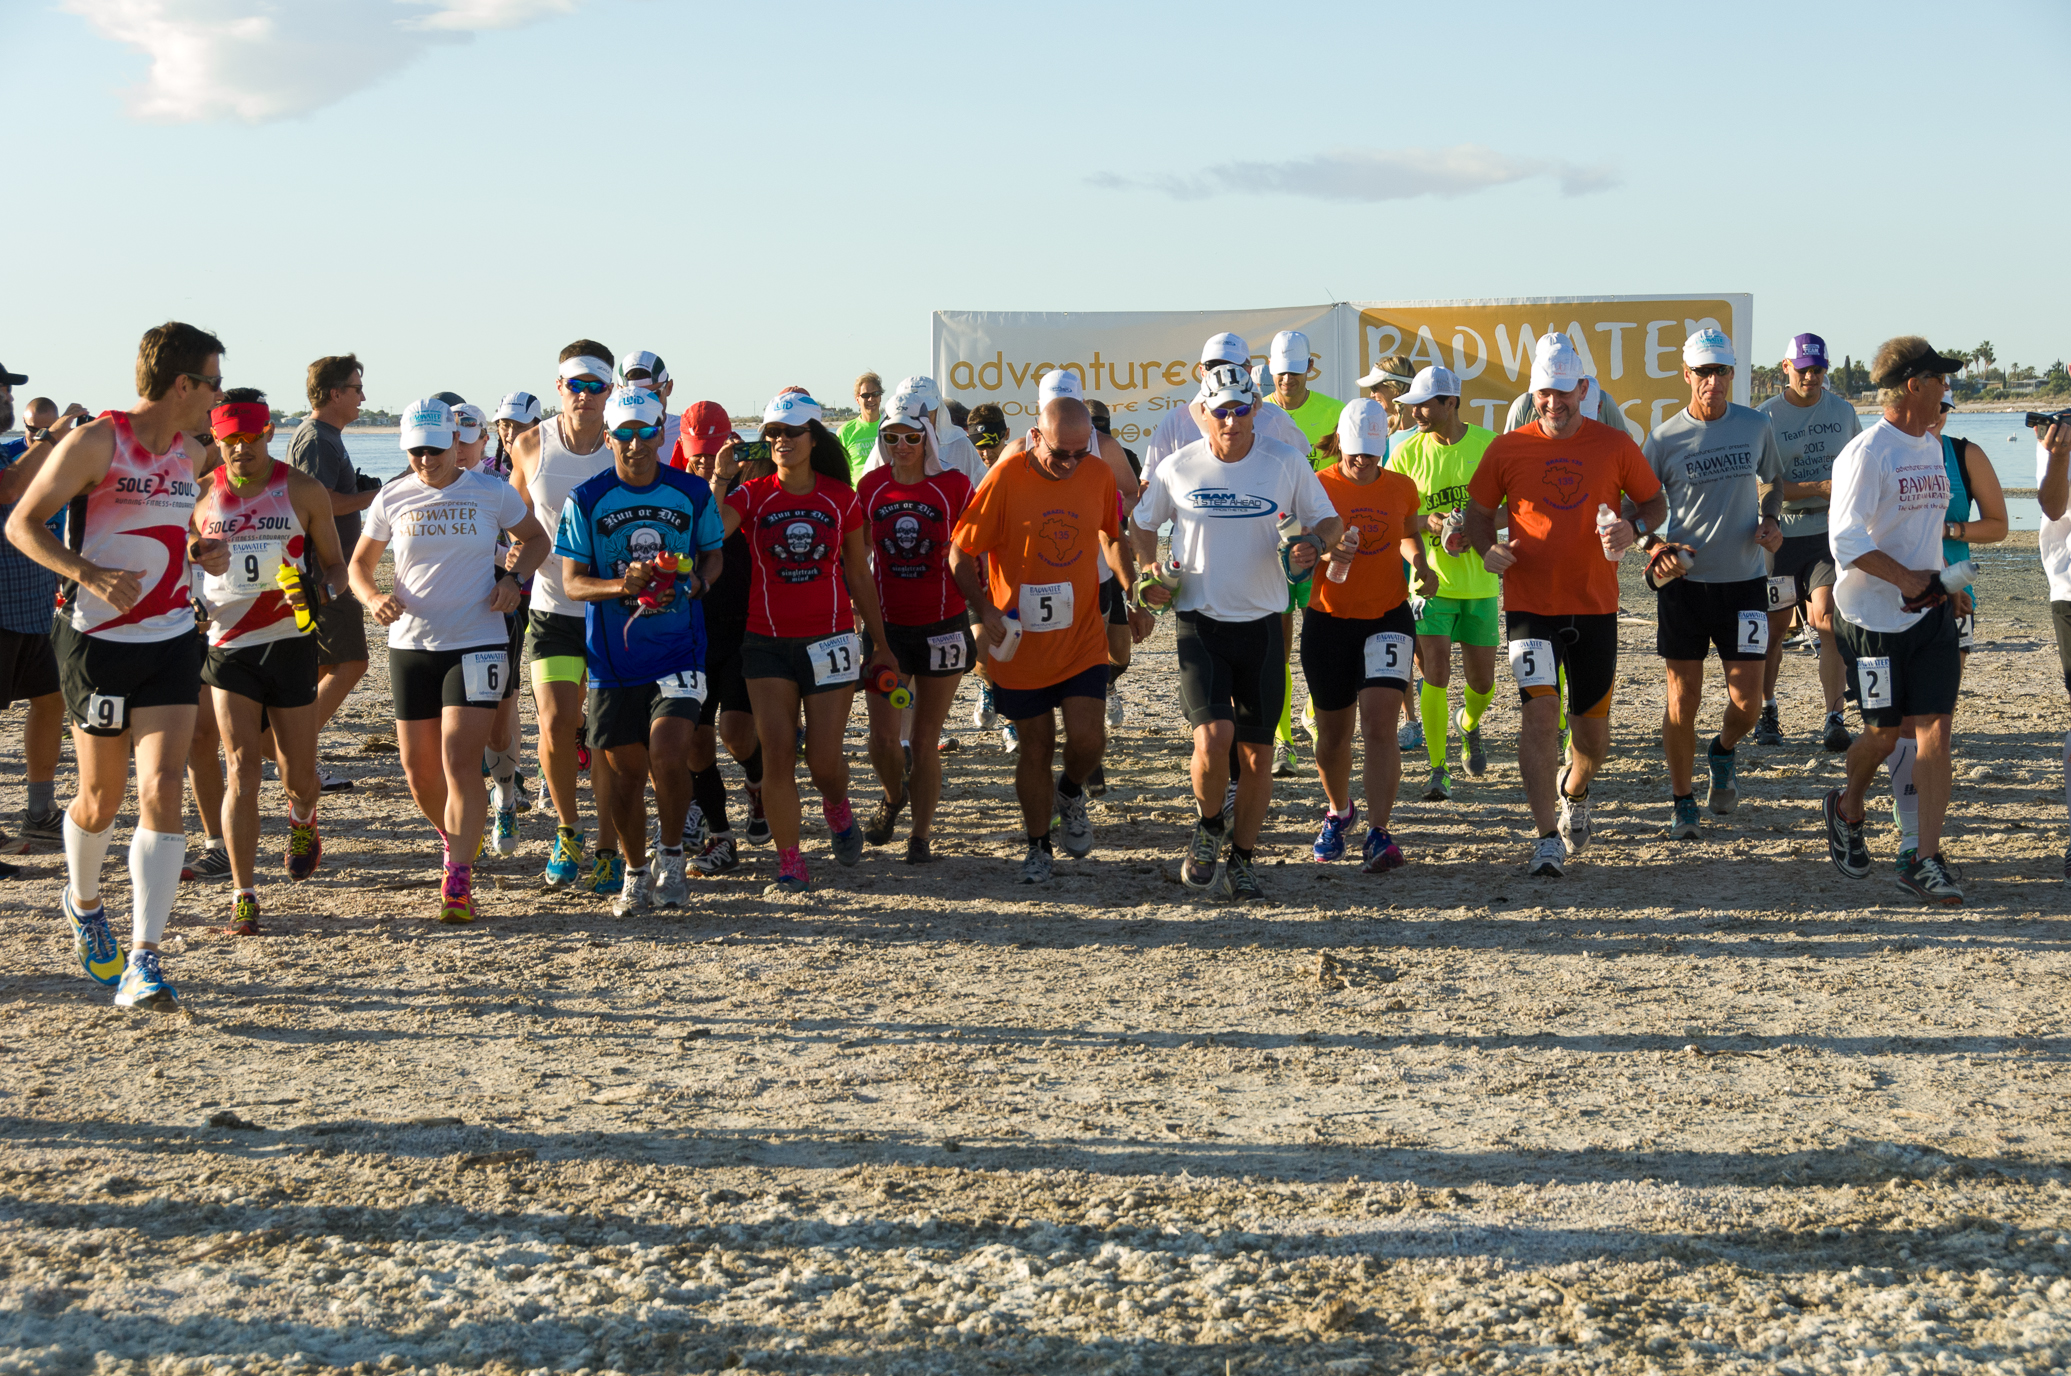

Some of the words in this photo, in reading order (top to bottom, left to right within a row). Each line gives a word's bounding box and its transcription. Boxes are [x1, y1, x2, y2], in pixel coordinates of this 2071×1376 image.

[1213, 368, 1240, 387] 11
[1781, 429, 1806, 442] Team
[1808, 423, 1842, 436] FOMO
[1803, 441, 1825, 454] 2013
[1545, 457, 1569, 466] BRAZIL
[1685, 451, 1752, 475] BADWATER
[1558, 477, 1574, 486] 135
[1688, 464, 1753, 480] ULTRAMARATHON
[116, 477, 153, 493] SOLE
[170, 480, 195, 497] SOUL
[115, 498, 142, 506] RUNNING
[172, 501, 196, 509] ENDURANC
[1229, 499, 1262, 507] AHEAD
[1425, 485, 1471, 511] SALTON
[602, 509, 634, 529] Run
[637, 508, 652, 517] or
[656, 508, 682, 527] Die
[767, 511, 791, 525] Run
[810, 511, 830, 523] Die
[878, 503, 900, 518] Run
[917, 502, 936, 518] Die
[1042, 509, 1065, 518] BRAZIL
[208, 519, 238, 534] SOLE
[257, 517, 291, 530] SOUL
[399, 523, 447, 537] SALTON
[452, 522, 477, 536] SEA
[1053, 530, 1070, 540] 135
[1362, 524, 1379, 533] 135
[1357, 541, 1391, 555] AMARATHON
[244, 554, 259, 582] 9
[781, 567, 818, 577] singletrack
[1769, 586, 1780, 604] 8
[1040, 596, 1053, 623] 5
[1747, 620, 1760, 644] 2
[826, 646, 851, 674] 13
[938, 643, 961, 669] 13
[1385, 643, 1398, 668] 5
[1522, 650, 1535, 677] 5
[487, 663, 499, 691] 6
[675, 670, 698, 689] 13
[1865, 670, 1880, 698] 2
[98, 700, 115, 728] 9
